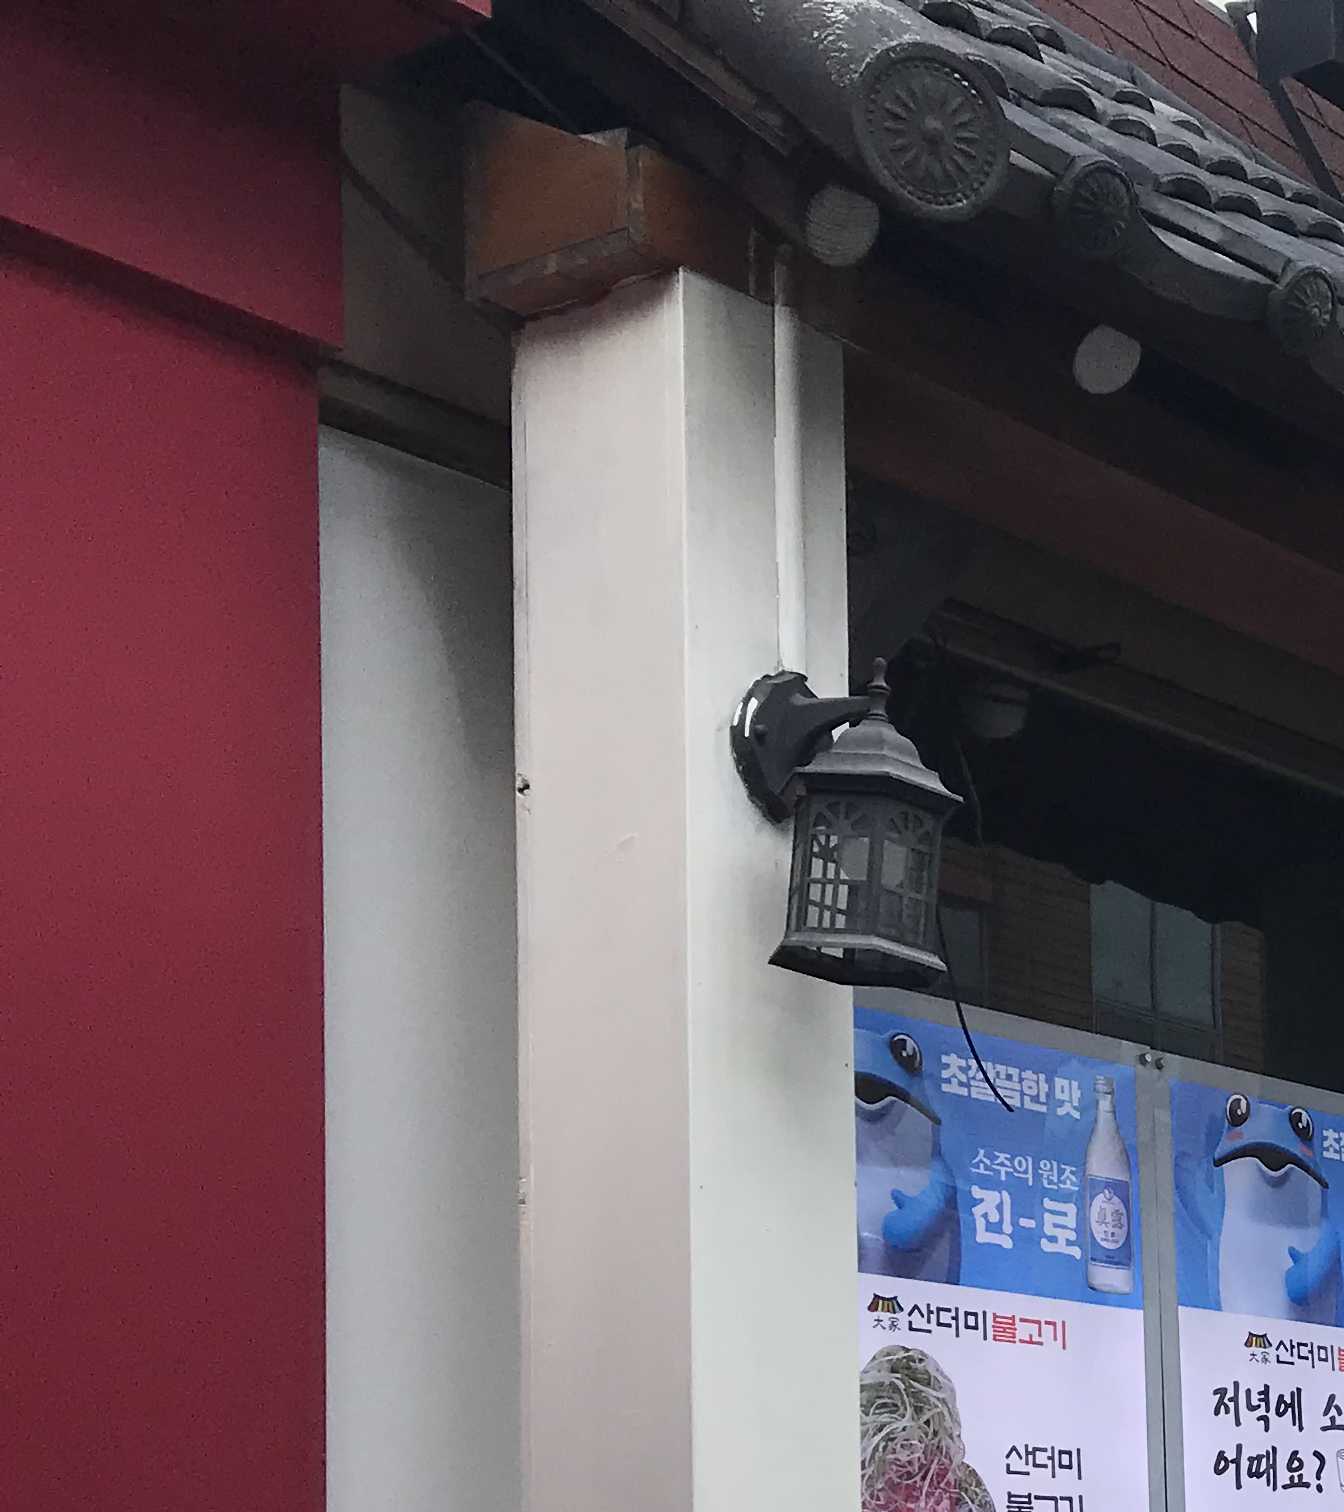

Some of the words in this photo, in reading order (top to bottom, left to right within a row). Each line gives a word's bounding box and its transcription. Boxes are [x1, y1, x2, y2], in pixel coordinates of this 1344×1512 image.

[1055, 1075, 1082, 1120] 맛
[970, 1148, 1034, 1187] 소주의
[1038, 1159, 1081, 1192] 원조
[1212, 1380, 1304, 1433] 저녁에
[1005, 1443, 1083, 1481] 산더미
[1213, 1443, 1327, 1494] 어때요?
